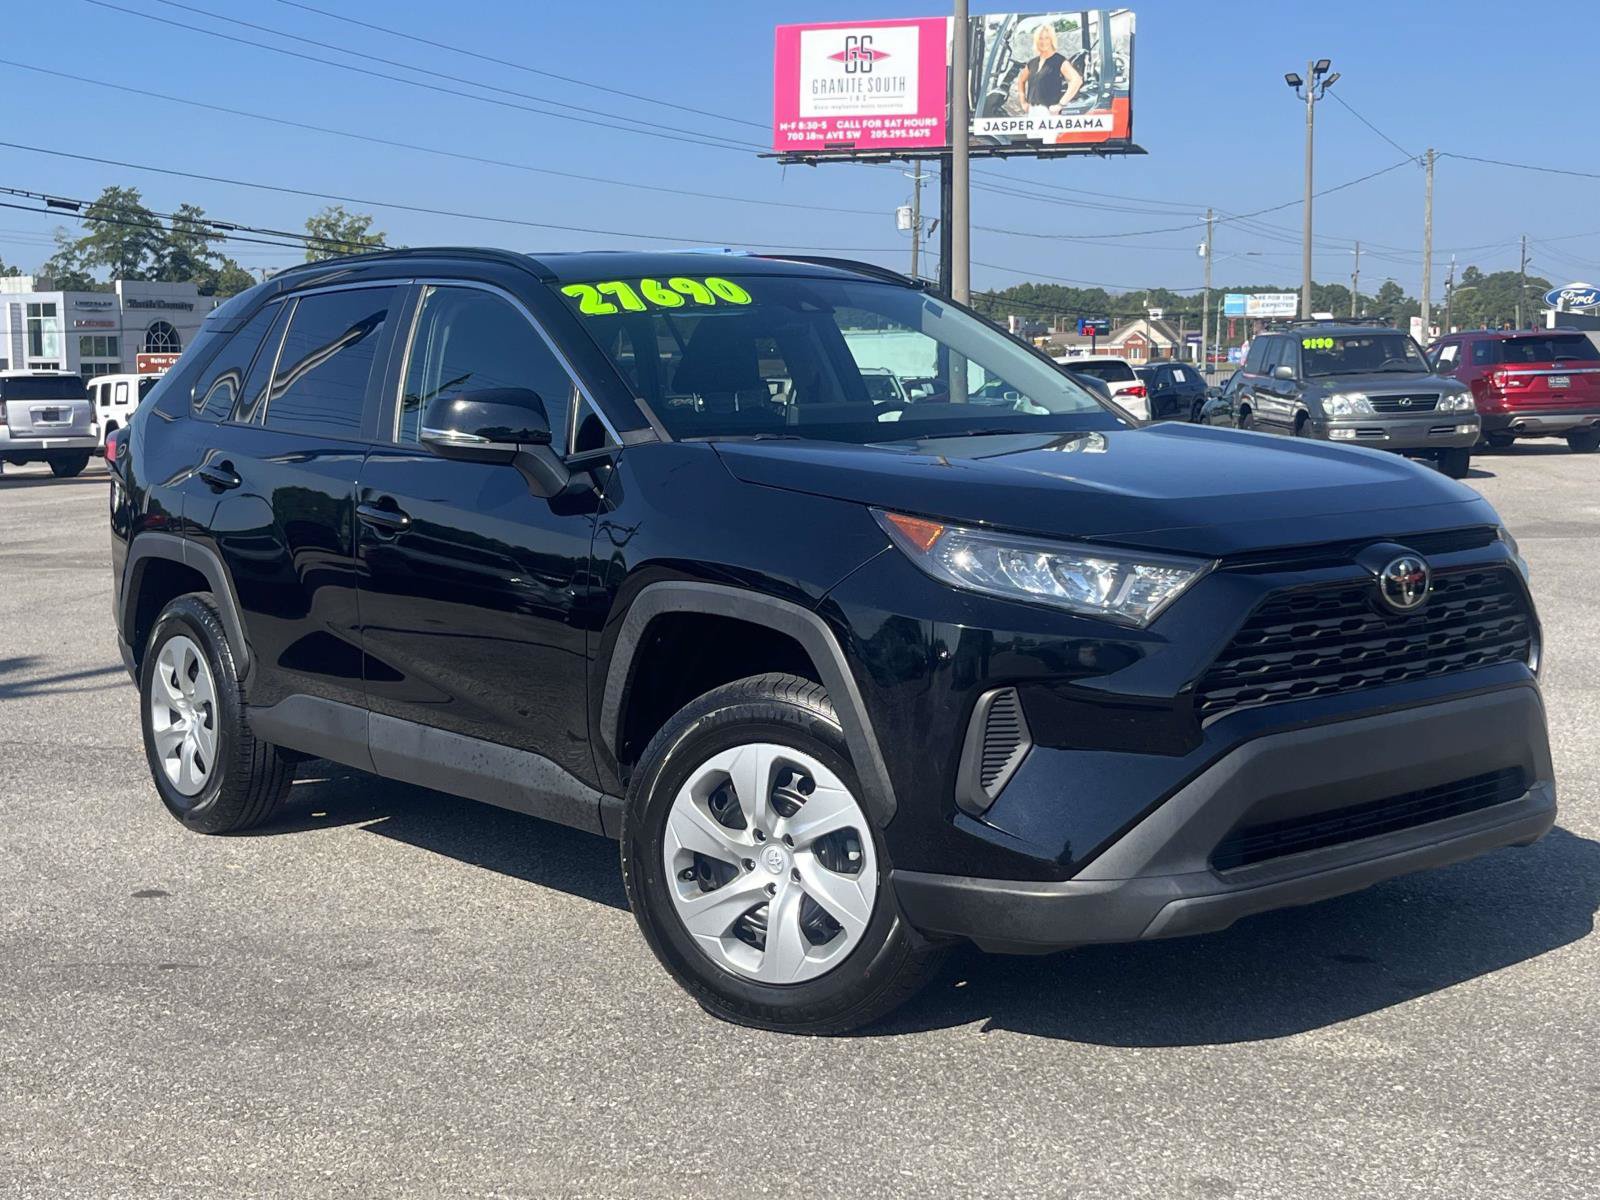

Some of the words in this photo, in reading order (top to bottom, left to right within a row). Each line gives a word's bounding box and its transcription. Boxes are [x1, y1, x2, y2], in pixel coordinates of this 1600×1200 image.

[845, 35, 873, 74] GS
[812, 77, 863, 95] GRANITE
[867, 76, 906, 93] SOUTH
[779, 122, 796, 131] M-F
[836, 119, 861, 129] CALL
[862, 118, 882, 128] FOR
[884, 118, 903, 127] SAT
[903, 117, 938, 127] HOURS
[983, 120, 1034, 132] JASPER
[1038, 118, 1104, 130] ALABAMA
[787, 132, 804, 141] 700
[824, 130, 844, 139] AVE
[845, 130, 862, 139] SW
[560, 277, 752, 315] 27690
[1556, 289, 1596, 306] Ford
[1302, 338, 1334, 349] 9190
